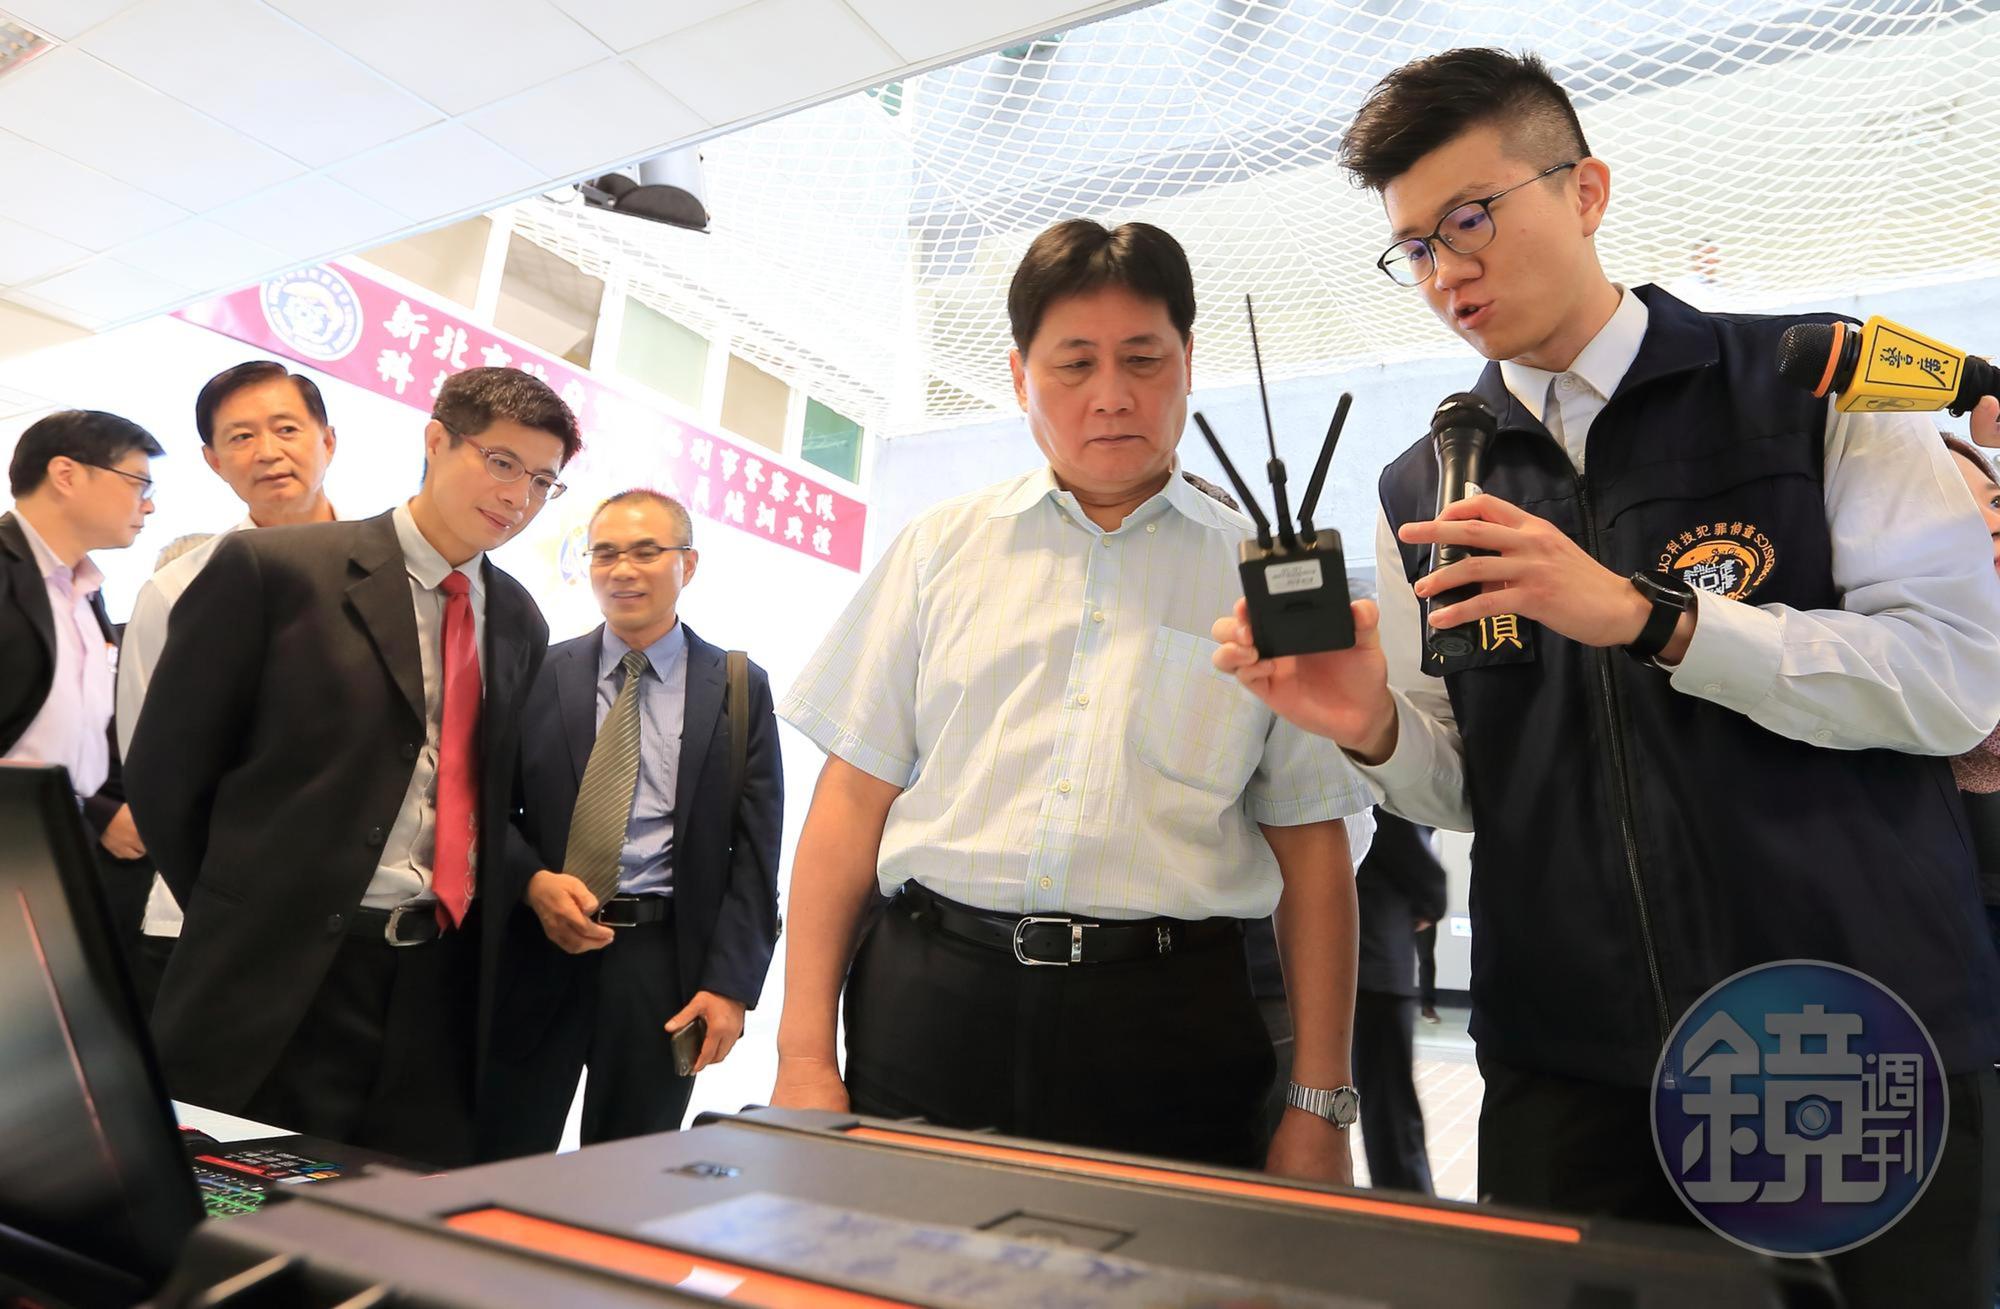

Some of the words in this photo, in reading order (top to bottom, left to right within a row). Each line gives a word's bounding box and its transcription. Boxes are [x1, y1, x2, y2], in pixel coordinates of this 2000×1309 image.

[1665, 521, 1757, 555] 科技犯罪偵查
